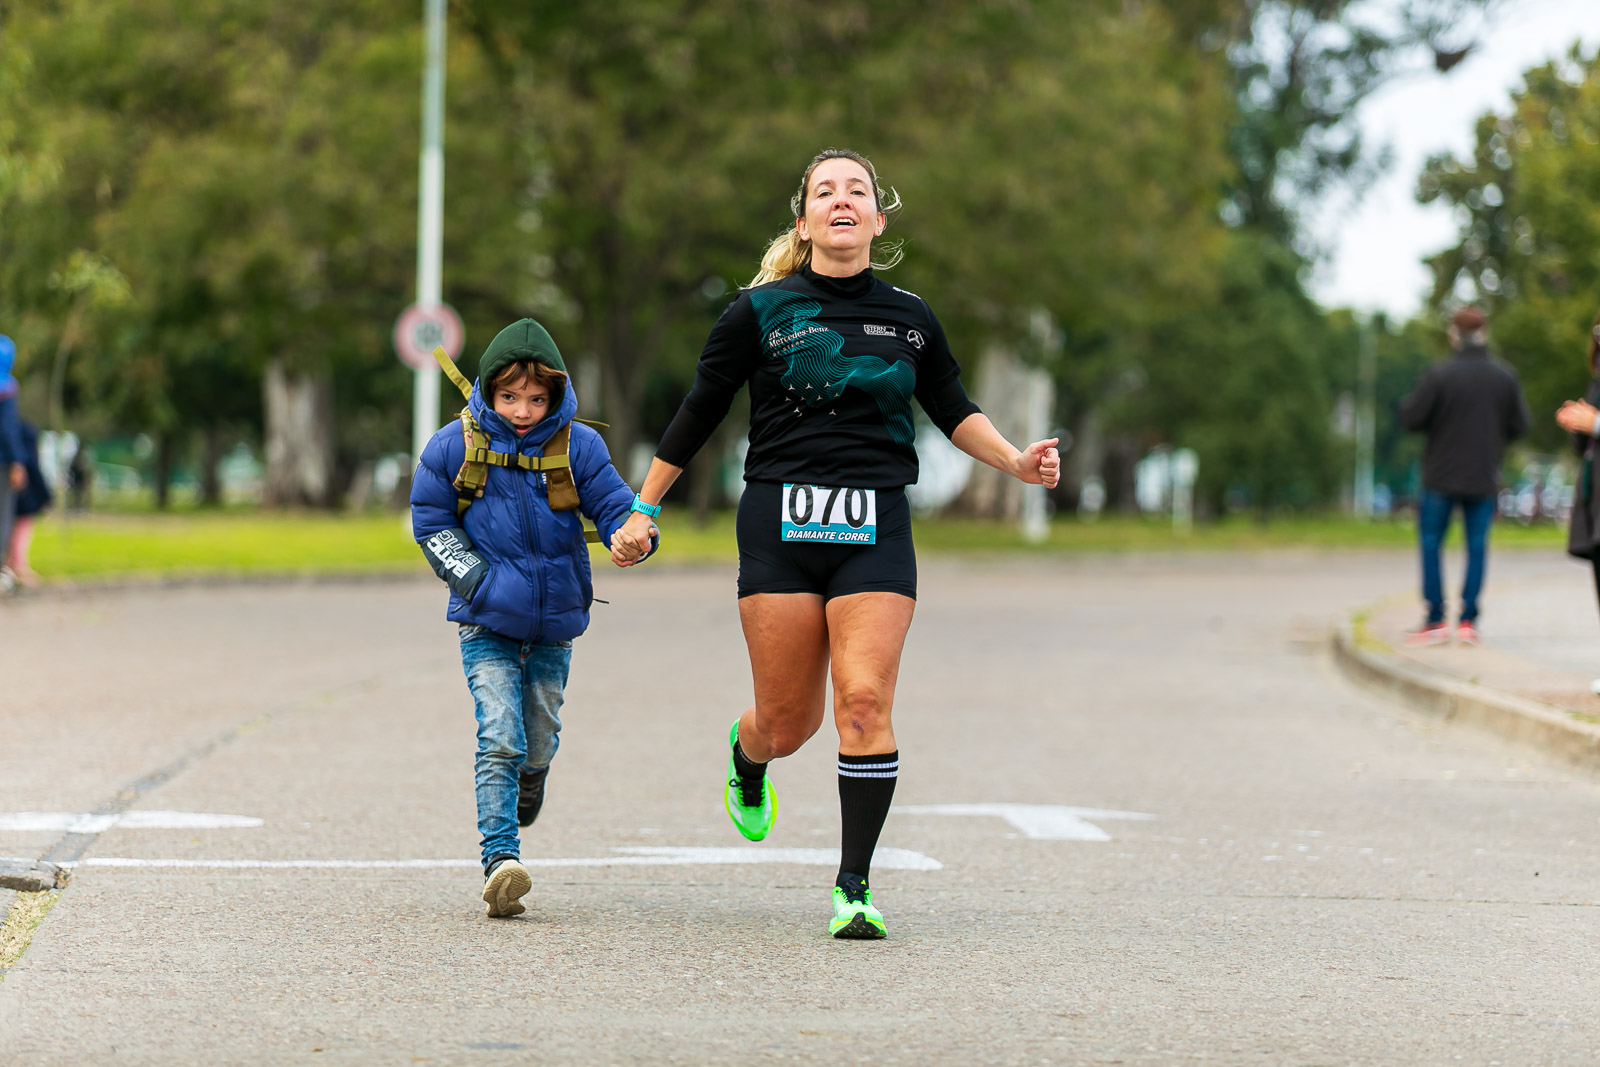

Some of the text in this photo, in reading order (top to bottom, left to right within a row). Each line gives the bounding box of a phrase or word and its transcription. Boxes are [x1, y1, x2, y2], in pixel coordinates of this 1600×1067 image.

[768, 326, 829, 348] Mercedes-Benz
[788, 483, 868, 529] 070
[435, 529, 482, 569] BATIC
[786, 530, 871, 542] DIAMANTE CORRE
[426, 537, 471, 579] BATIC
